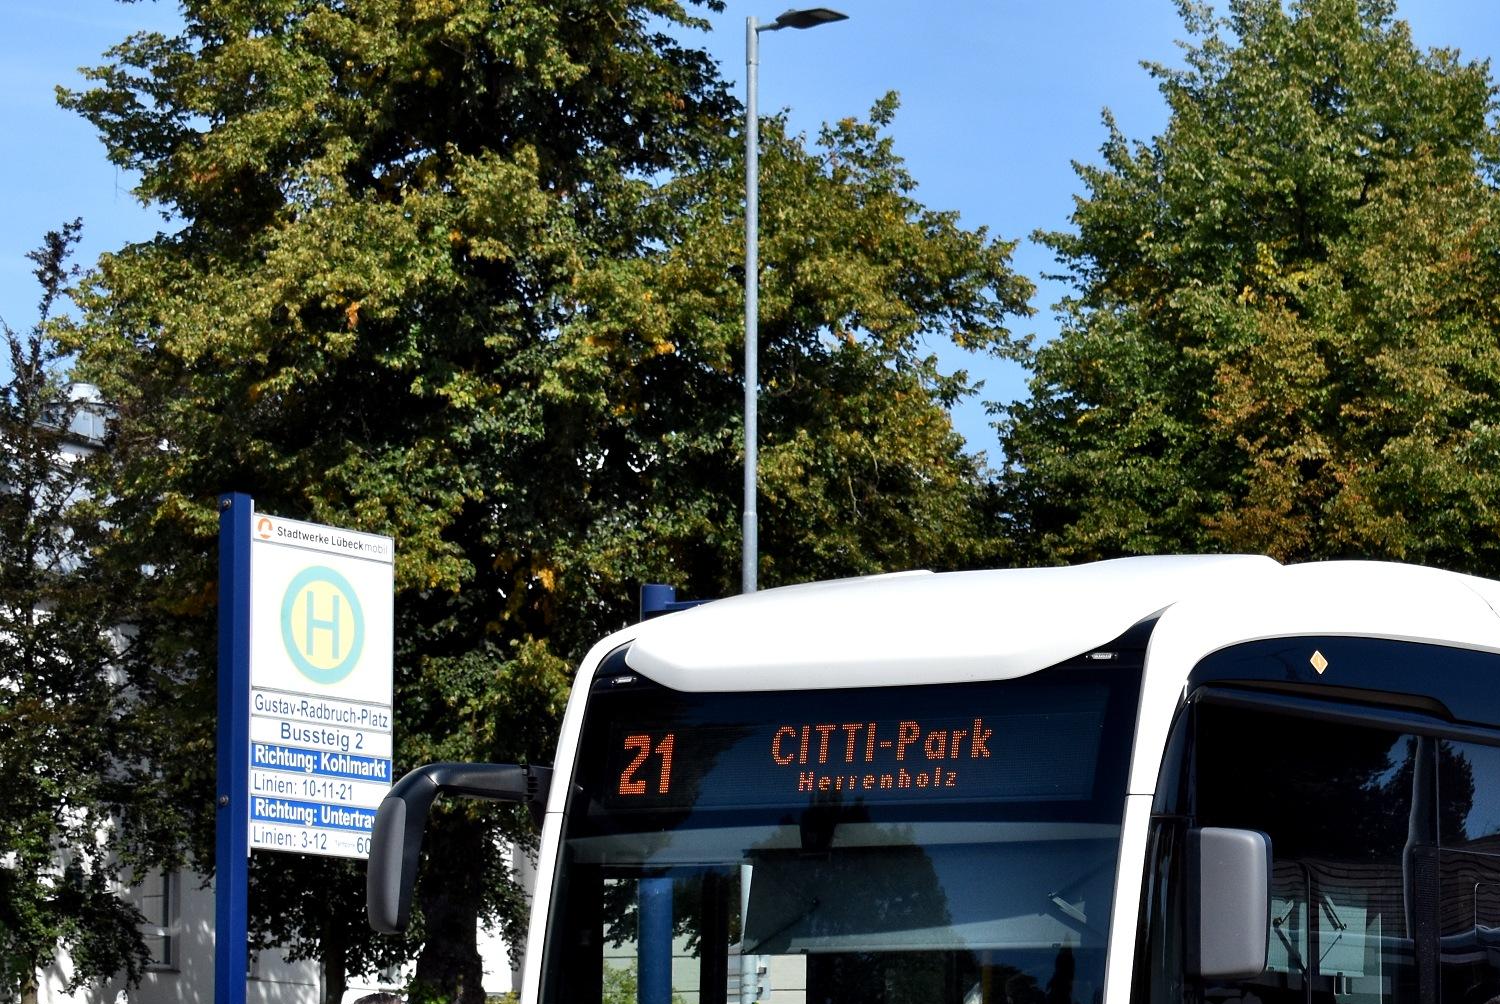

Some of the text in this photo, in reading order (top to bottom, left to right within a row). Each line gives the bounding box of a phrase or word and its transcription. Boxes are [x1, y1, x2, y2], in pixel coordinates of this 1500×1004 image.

[277, 526, 329, 545] Stadtwerke
[306, 590, 340, 660] H
[254, 693, 388, 728] Gustav-Radbruch-Platz
[281, 722, 364, 752] Bussteig 2
[772, 717, 993, 766] CITTI-Park
[255, 744, 387, 778] Richtung: Kohlmarkt
[618, 733, 675, 796] 21
[254, 773, 353, 801] Linien: 10-11-21
[798, 767, 957, 792] Herrenholz
[255, 798, 318, 826] Richtung:
[253, 826, 297, 847] Linien:
[301, 831, 327, 851] 3-12
